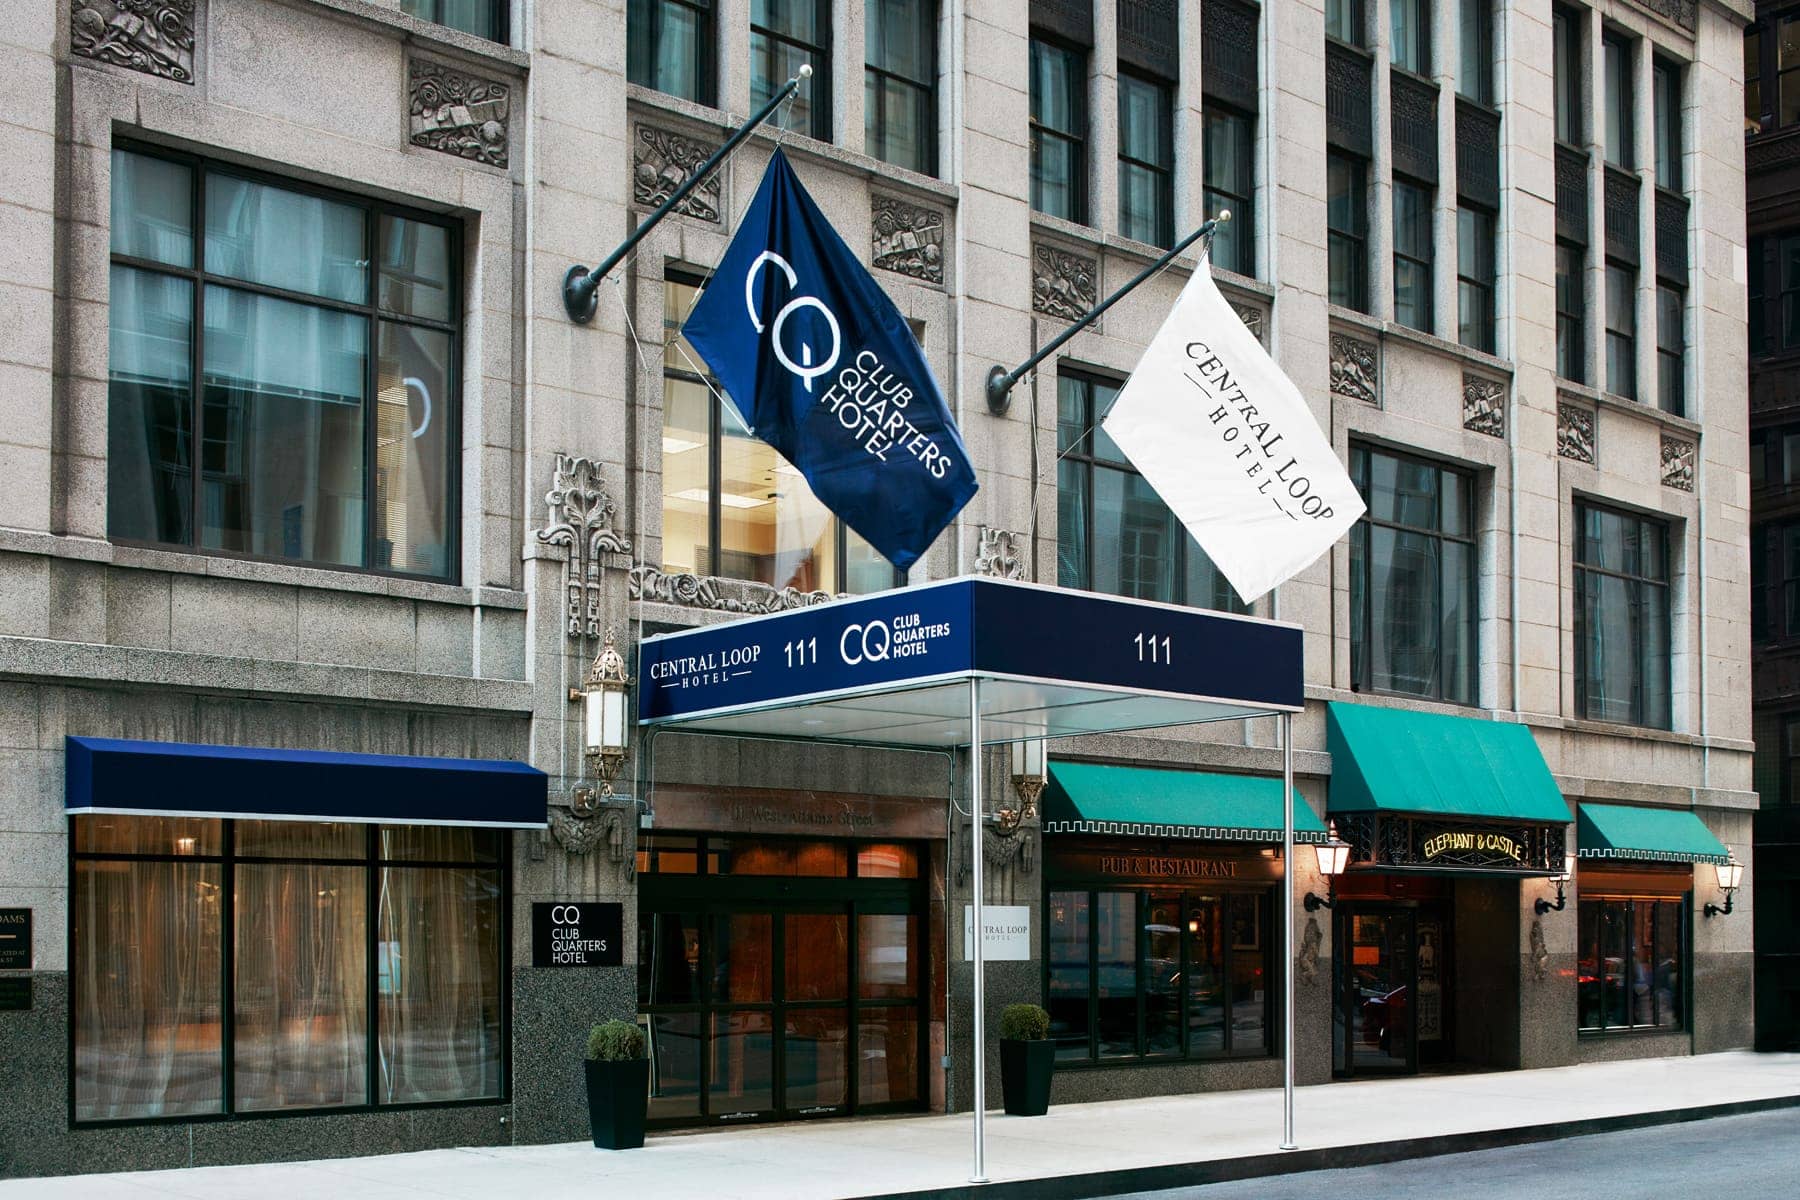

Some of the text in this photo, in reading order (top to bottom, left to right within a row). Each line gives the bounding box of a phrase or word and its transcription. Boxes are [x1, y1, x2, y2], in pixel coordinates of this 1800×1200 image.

[745, 250, 841, 393] CQ
[855, 350, 914, 410] CLUB
[821, 384, 895, 462] HOTEL
[839, 367, 951, 479] QUARTERS
[1185, 341, 1334, 521] CENTRAL LOOP
[1208, 404, 1275, 495] HOTEL
[893, 614, 921, 629] CLUB
[893, 623, 950, 645] QUARTERS
[784, 637, 817, 668] 111
[840, 620, 890, 665] CQ
[893, 642, 928, 659] HOTEL
[1134, 632, 1170, 665] 111
[650, 645, 761, 679] CENTRAL LOOP
[682, 672, 729, 689] HOTEL
[1424, 833, 1523, 861] ELEPHANT & CASTLE
[1102, 857, 1238, 877] PUB & RESTAURANT
[551, 905, 580, 925] CQ
[552, 928, 580, 940] CLUB
[968, 926, 1028, 934] CTRAL LOOP
[551, 940, 607, 952] QUARTERS
[552, 952, 588, 964] HOTEL
